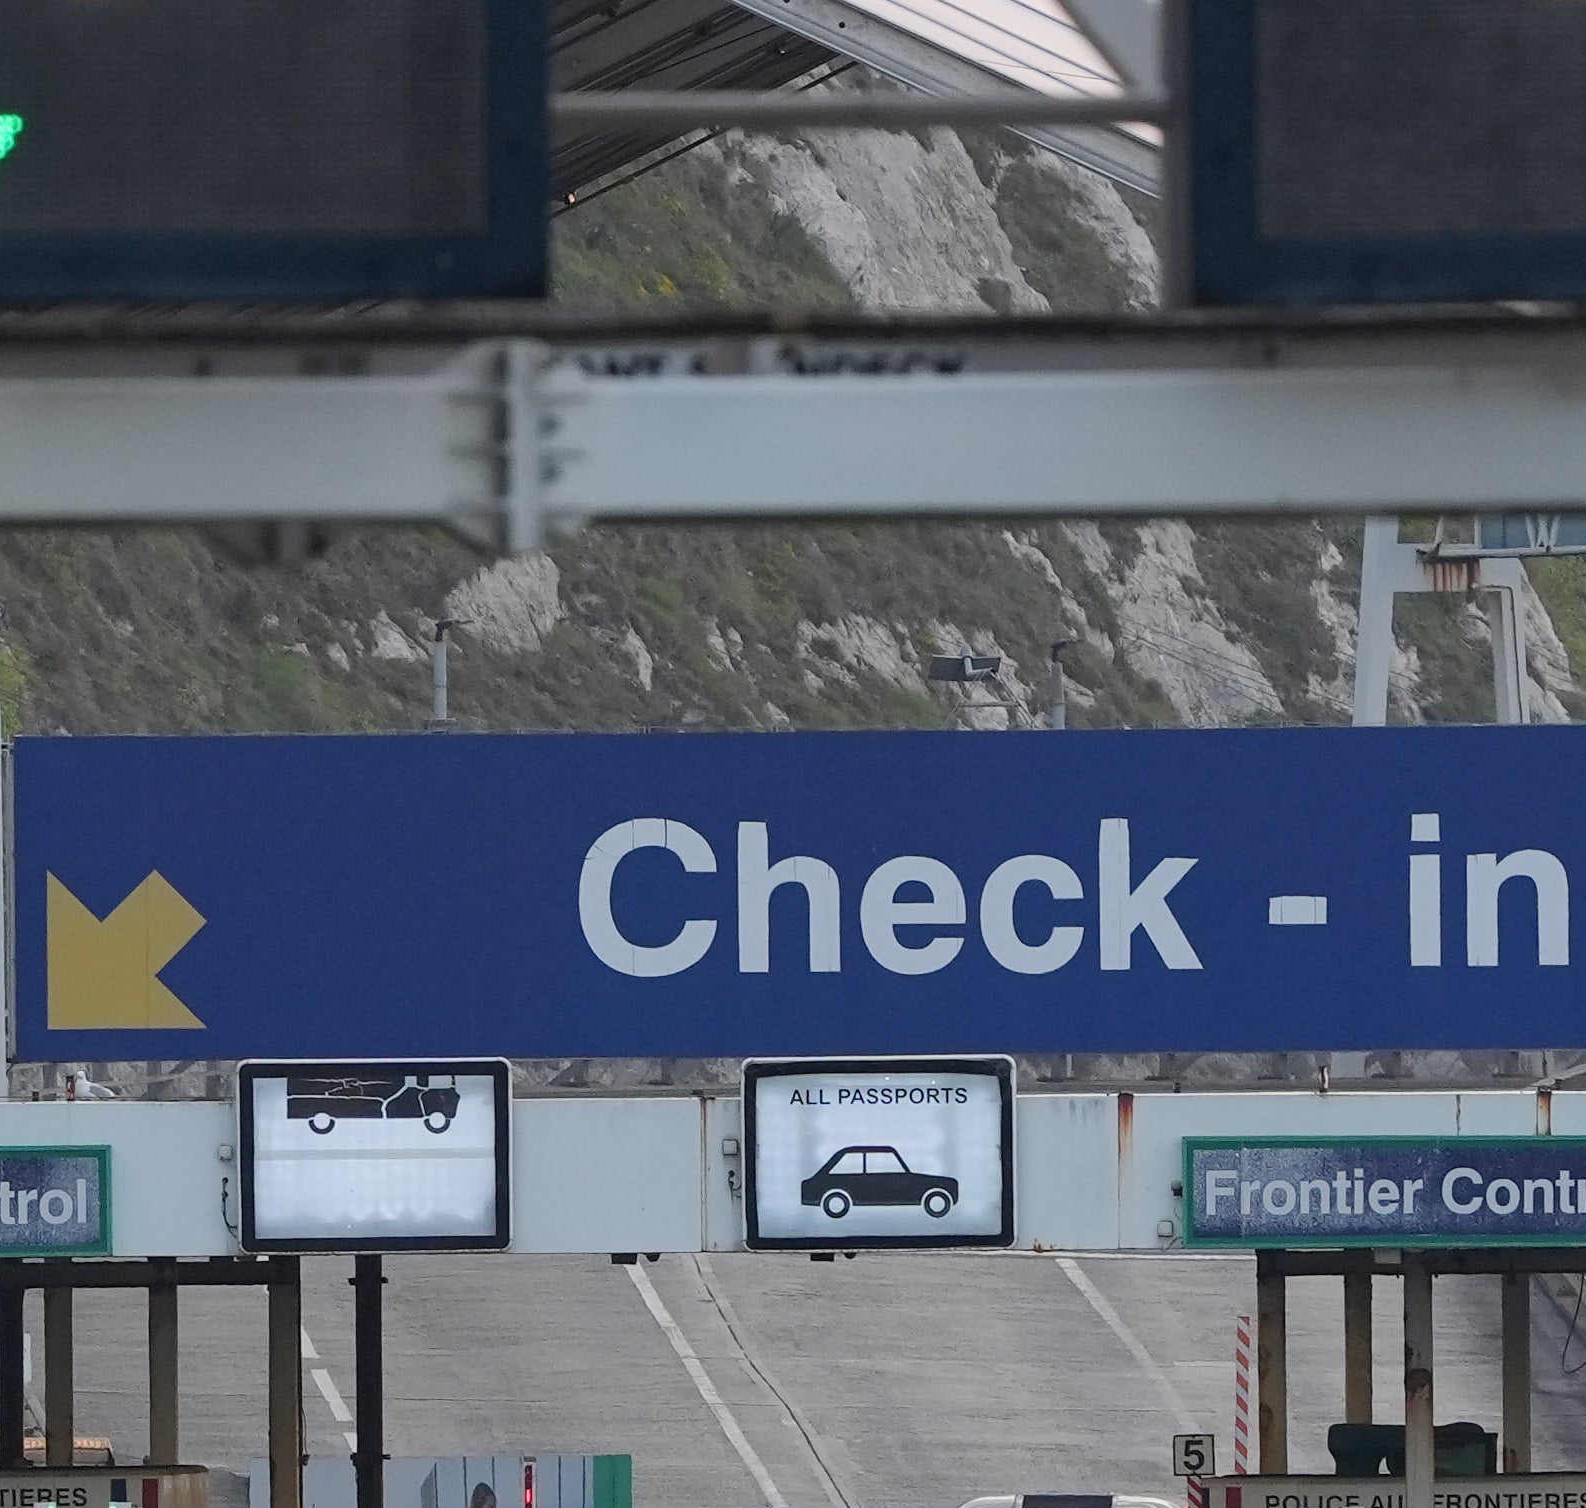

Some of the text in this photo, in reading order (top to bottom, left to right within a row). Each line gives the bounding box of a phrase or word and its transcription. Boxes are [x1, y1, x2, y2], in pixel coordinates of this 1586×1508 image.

[578, 813, 1570, 977] Check - in
[790, 1086, 969, 1105] ALL PASSPORTS
[1204, 1167, 1424, 1217] Frontier
[1182, 1438, 1205, 1471] 5
